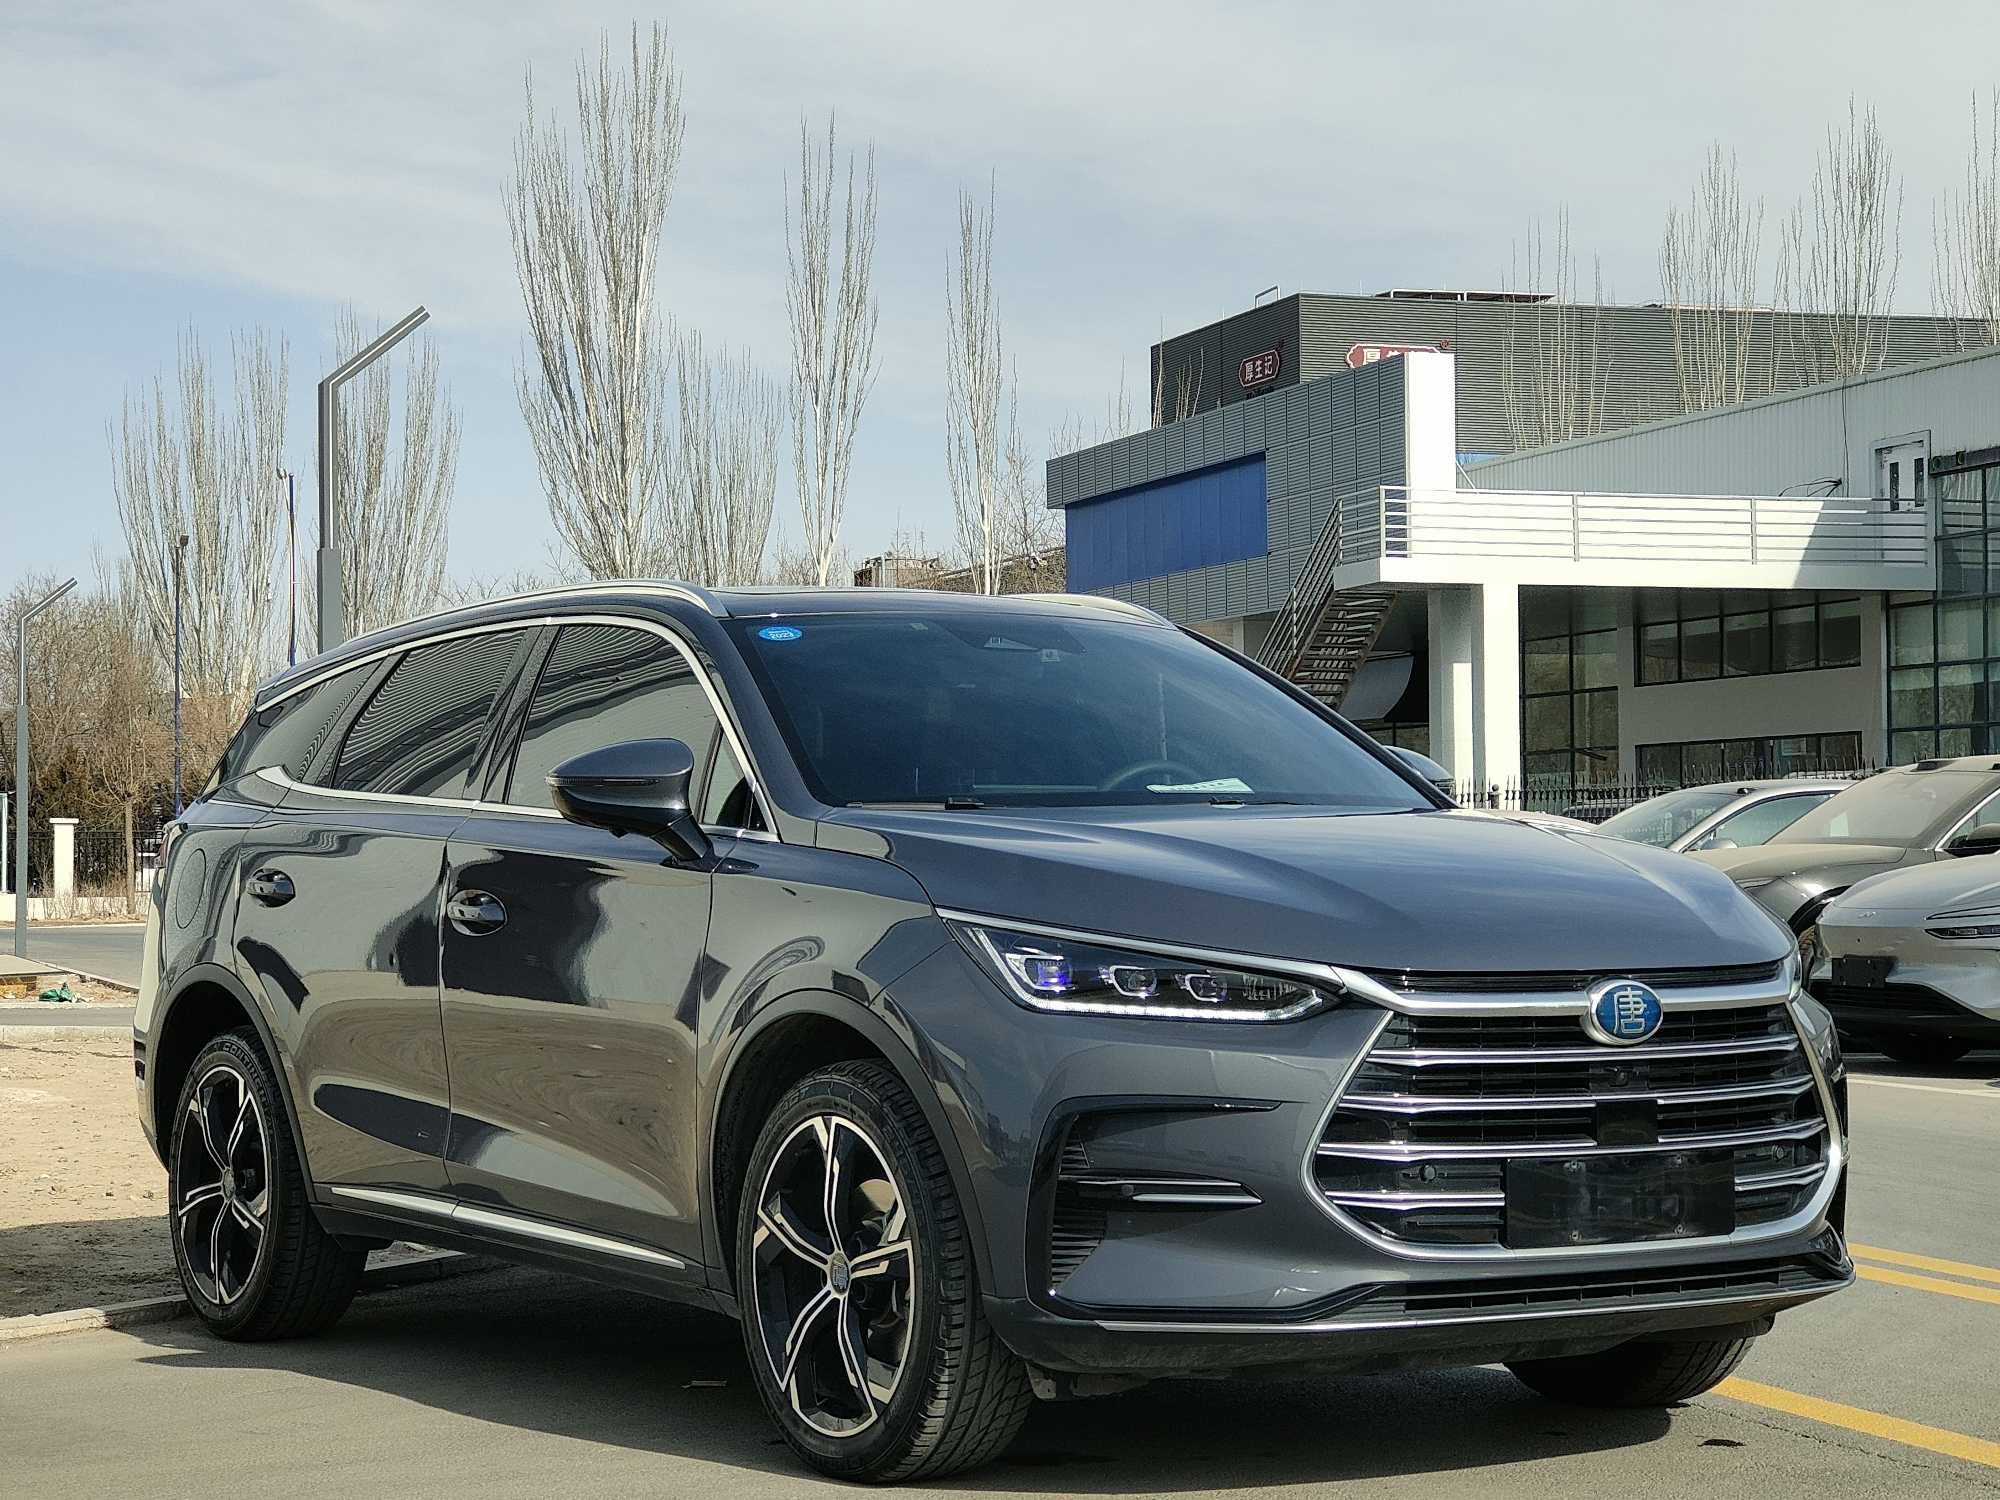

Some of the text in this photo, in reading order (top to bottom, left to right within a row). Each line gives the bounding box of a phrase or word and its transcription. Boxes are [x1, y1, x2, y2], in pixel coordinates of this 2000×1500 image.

[1245, 355, 1273, 382] 厚生记
[1613, 986, 1648, 1034] 唐
